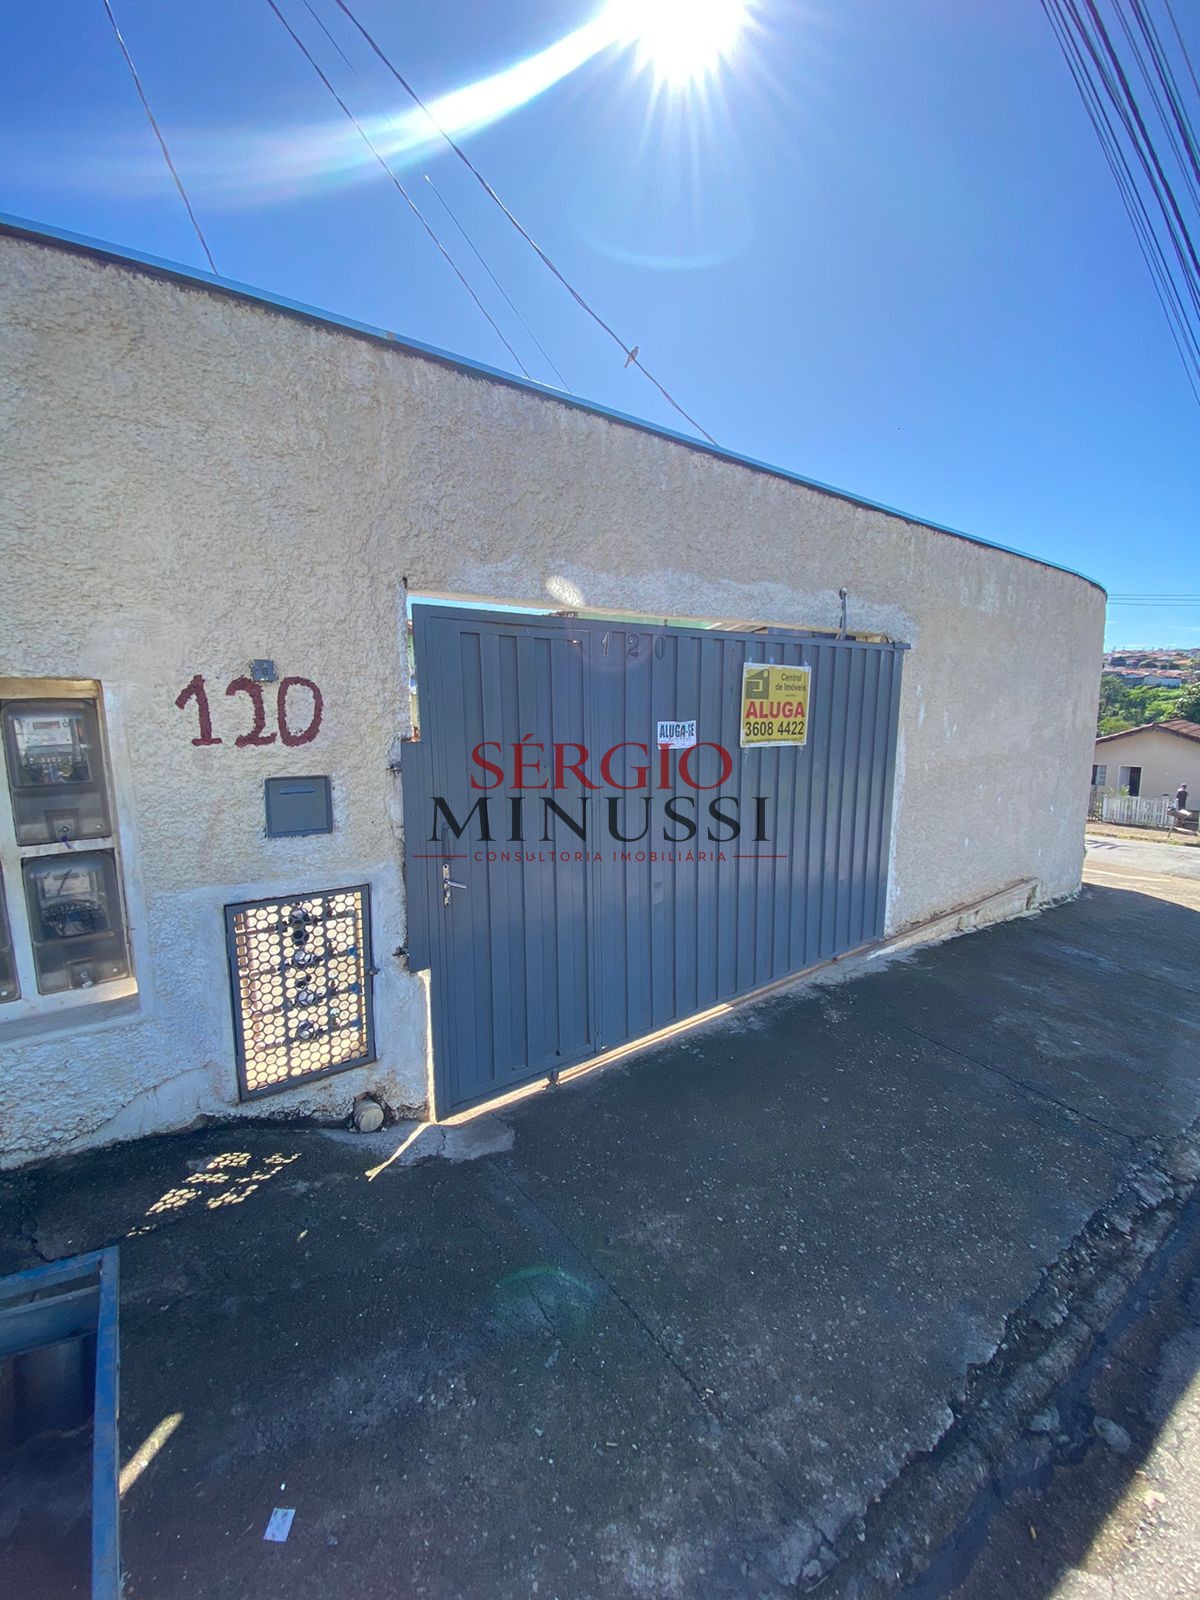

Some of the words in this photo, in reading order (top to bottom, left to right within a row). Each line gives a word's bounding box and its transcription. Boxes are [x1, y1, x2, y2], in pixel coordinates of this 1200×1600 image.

[601, 631, 666, 660] 120
[781, 672, 802, 682] Central
[775, 683, 783, 691] de
[784, 682, 806, 692] Imóveis
[175, 674, 324, 747] 120
[745, 701, 805, 719] ALUGA
[660, 723, 694, 738] ALUGA-SE
[745, 721, 774, 736] 3608
[777, 721, 804, 735] 4422
